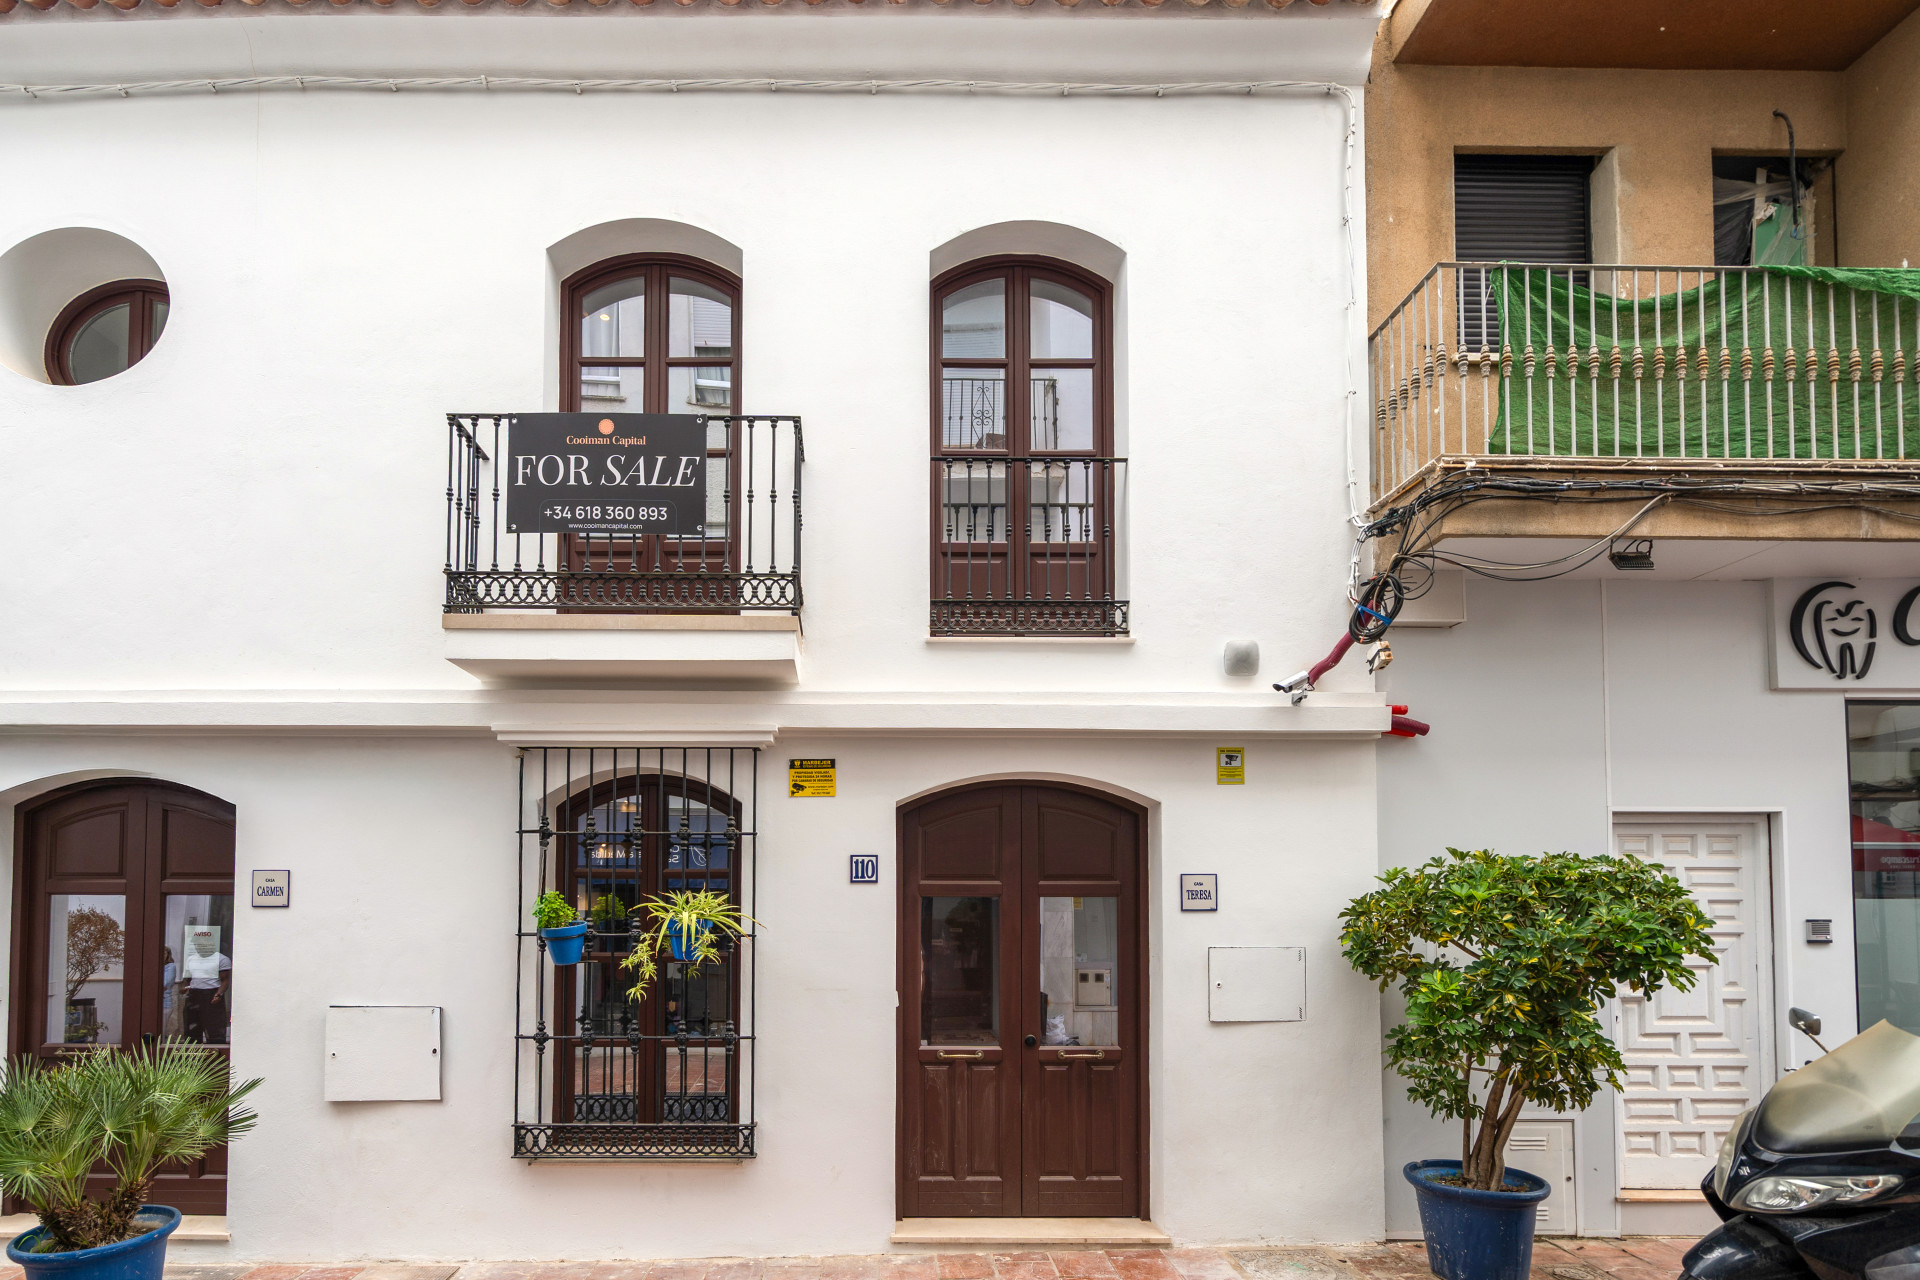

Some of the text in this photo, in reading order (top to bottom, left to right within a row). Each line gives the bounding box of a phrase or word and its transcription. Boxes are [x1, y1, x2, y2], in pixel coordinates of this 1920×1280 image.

[566, 435, 646, 447] Cooiman Capital
[514, 454, 700, 487] FOR SALE
[544, 506, 668, 520] +34 618 360 893
[568, 522, 643, 530] www.cooimancapital.com
[854, 858, 876, 879] 110
[257, 886, 284, 896] CARMEN
[1186, 890, 1212, 900] TERESA
